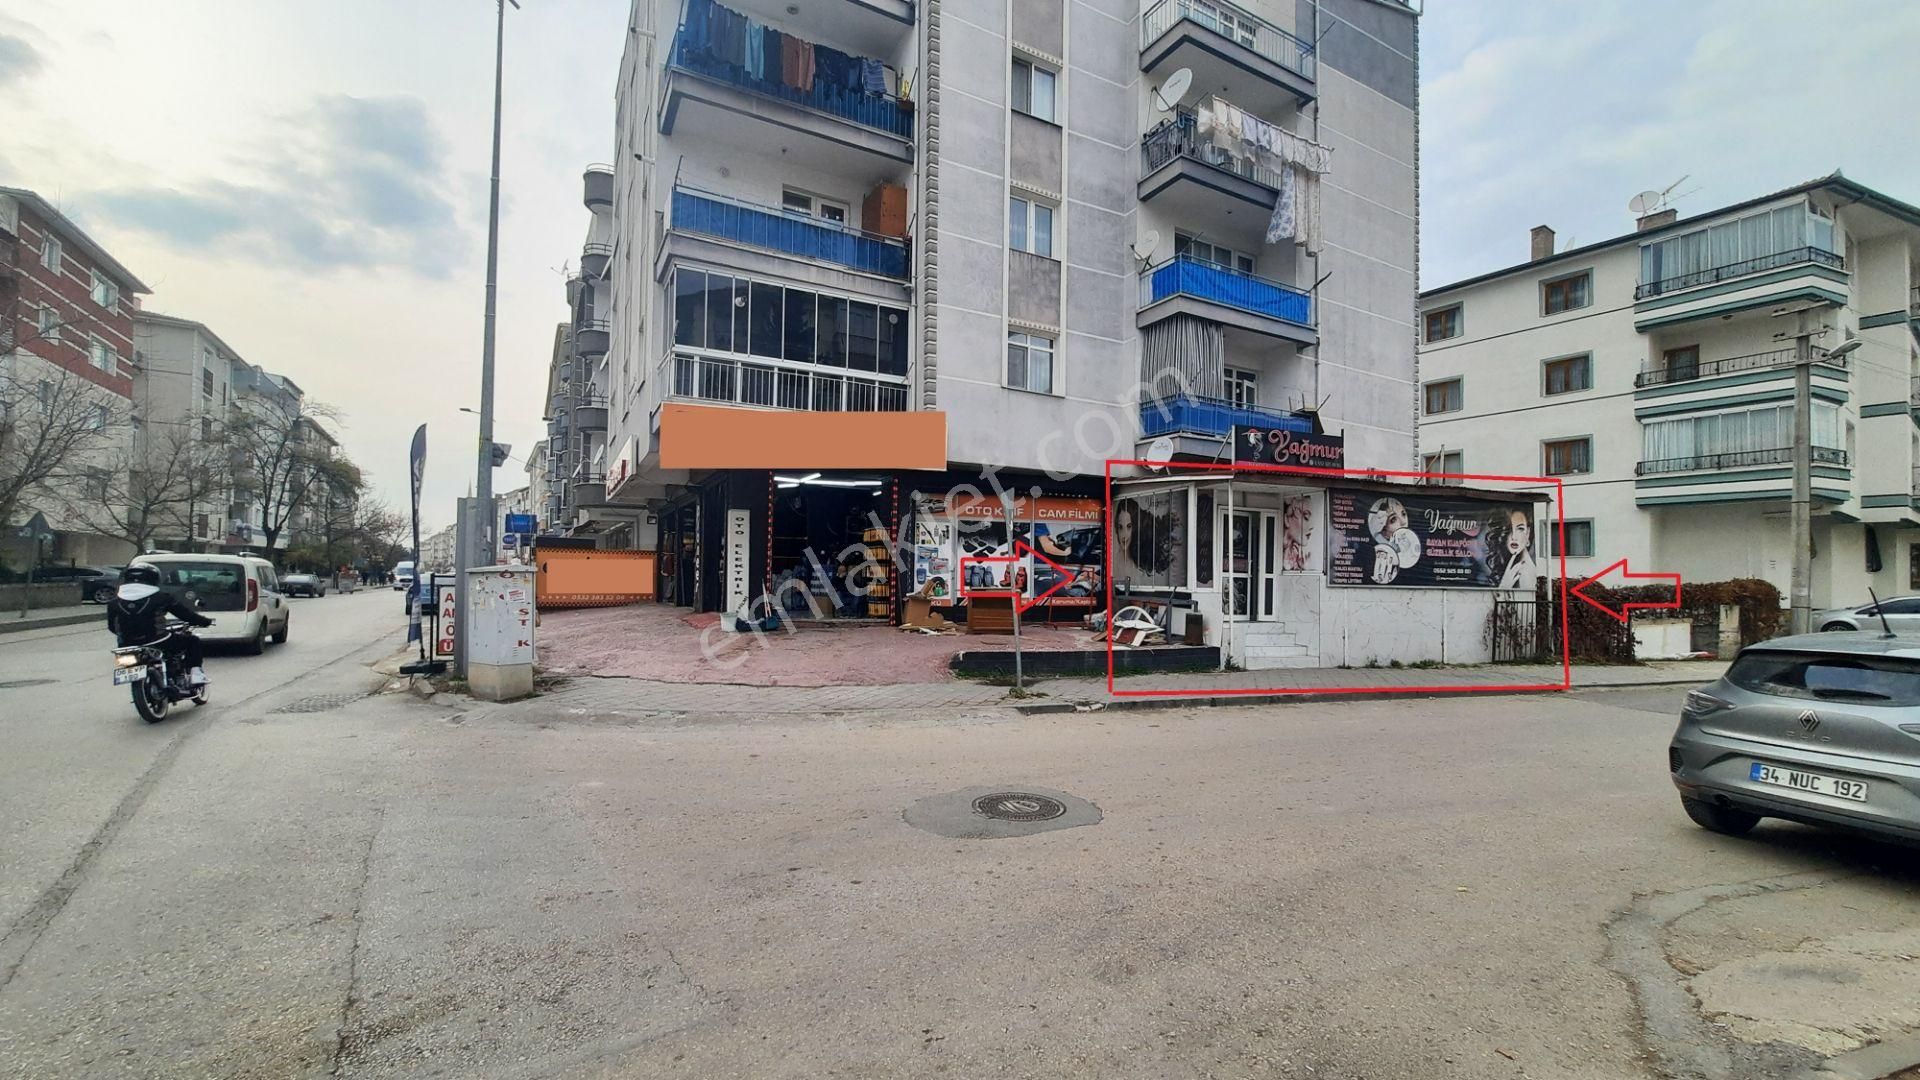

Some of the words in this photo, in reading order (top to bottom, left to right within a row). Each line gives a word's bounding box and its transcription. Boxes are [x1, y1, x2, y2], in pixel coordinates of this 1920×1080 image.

[1268, 429, 1344, 464] Yağmur
[965, 505, 992, 516] OTO
[994, 507, 1024, 517] KIF
[1038, 508, 1066, 519] CAM
[1424, 508, 1479, 536] Yağmur
[735, 516, 745, 535] OTO
[1760, 767, 1779, 783] 34
[1789, 771, 1821, 790] NUC
[1833, 779, 1863, 799] 192
